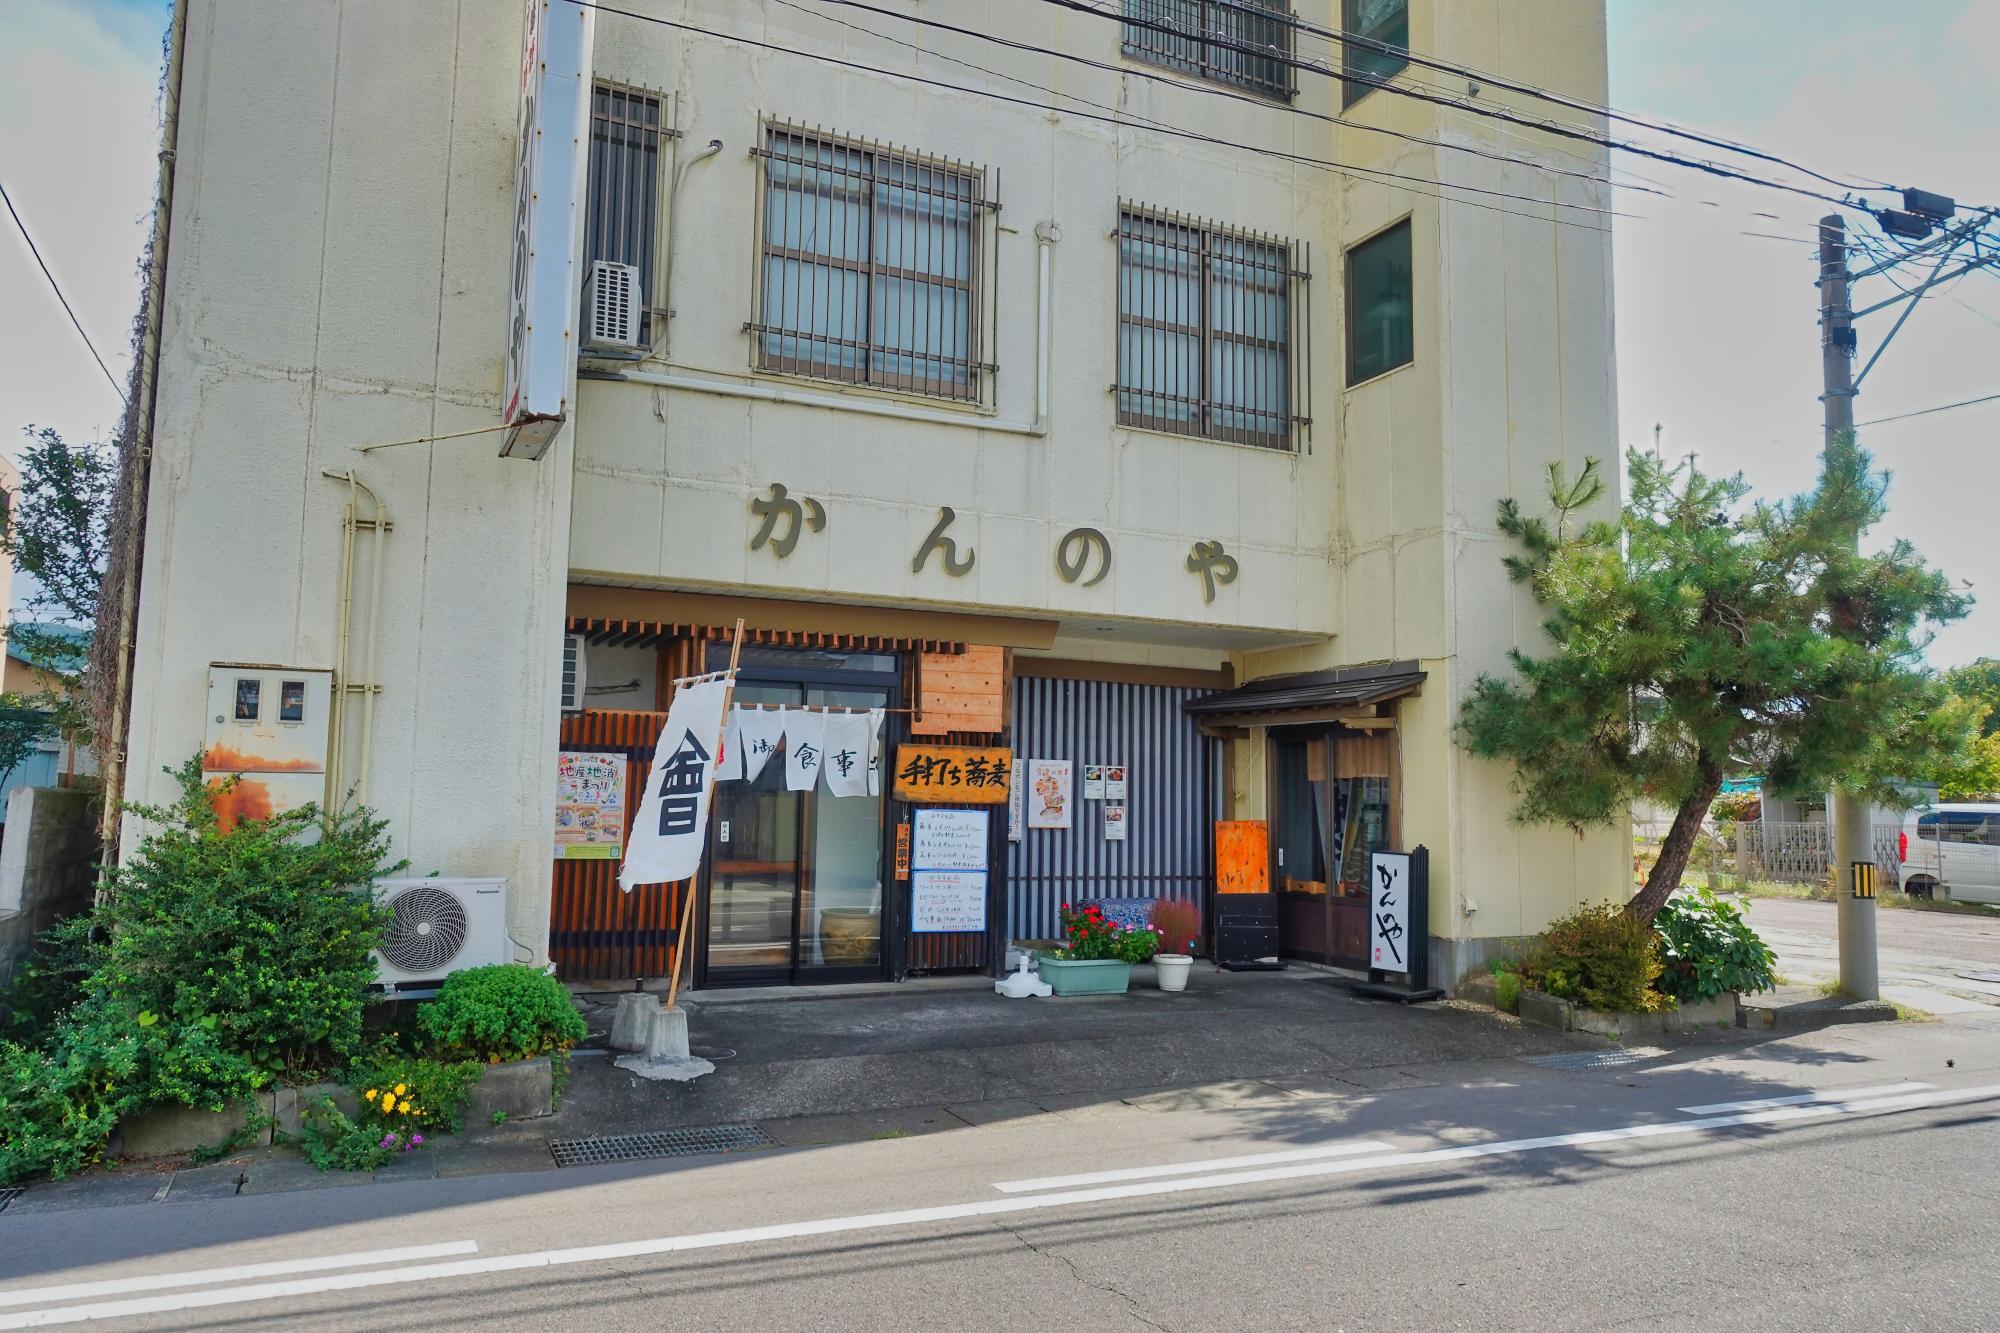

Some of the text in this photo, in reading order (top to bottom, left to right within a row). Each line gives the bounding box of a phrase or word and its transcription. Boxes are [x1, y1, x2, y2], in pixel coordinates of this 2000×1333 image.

[750, 482, 1239, 604] かんのや
[560, 765, 616, 780] 地産地消
[582, 778, 610, 792] まつり
[899, 754, 1011, 788] 手打ち蕎麦
[1376, 863, 1403, 964] かんのや
